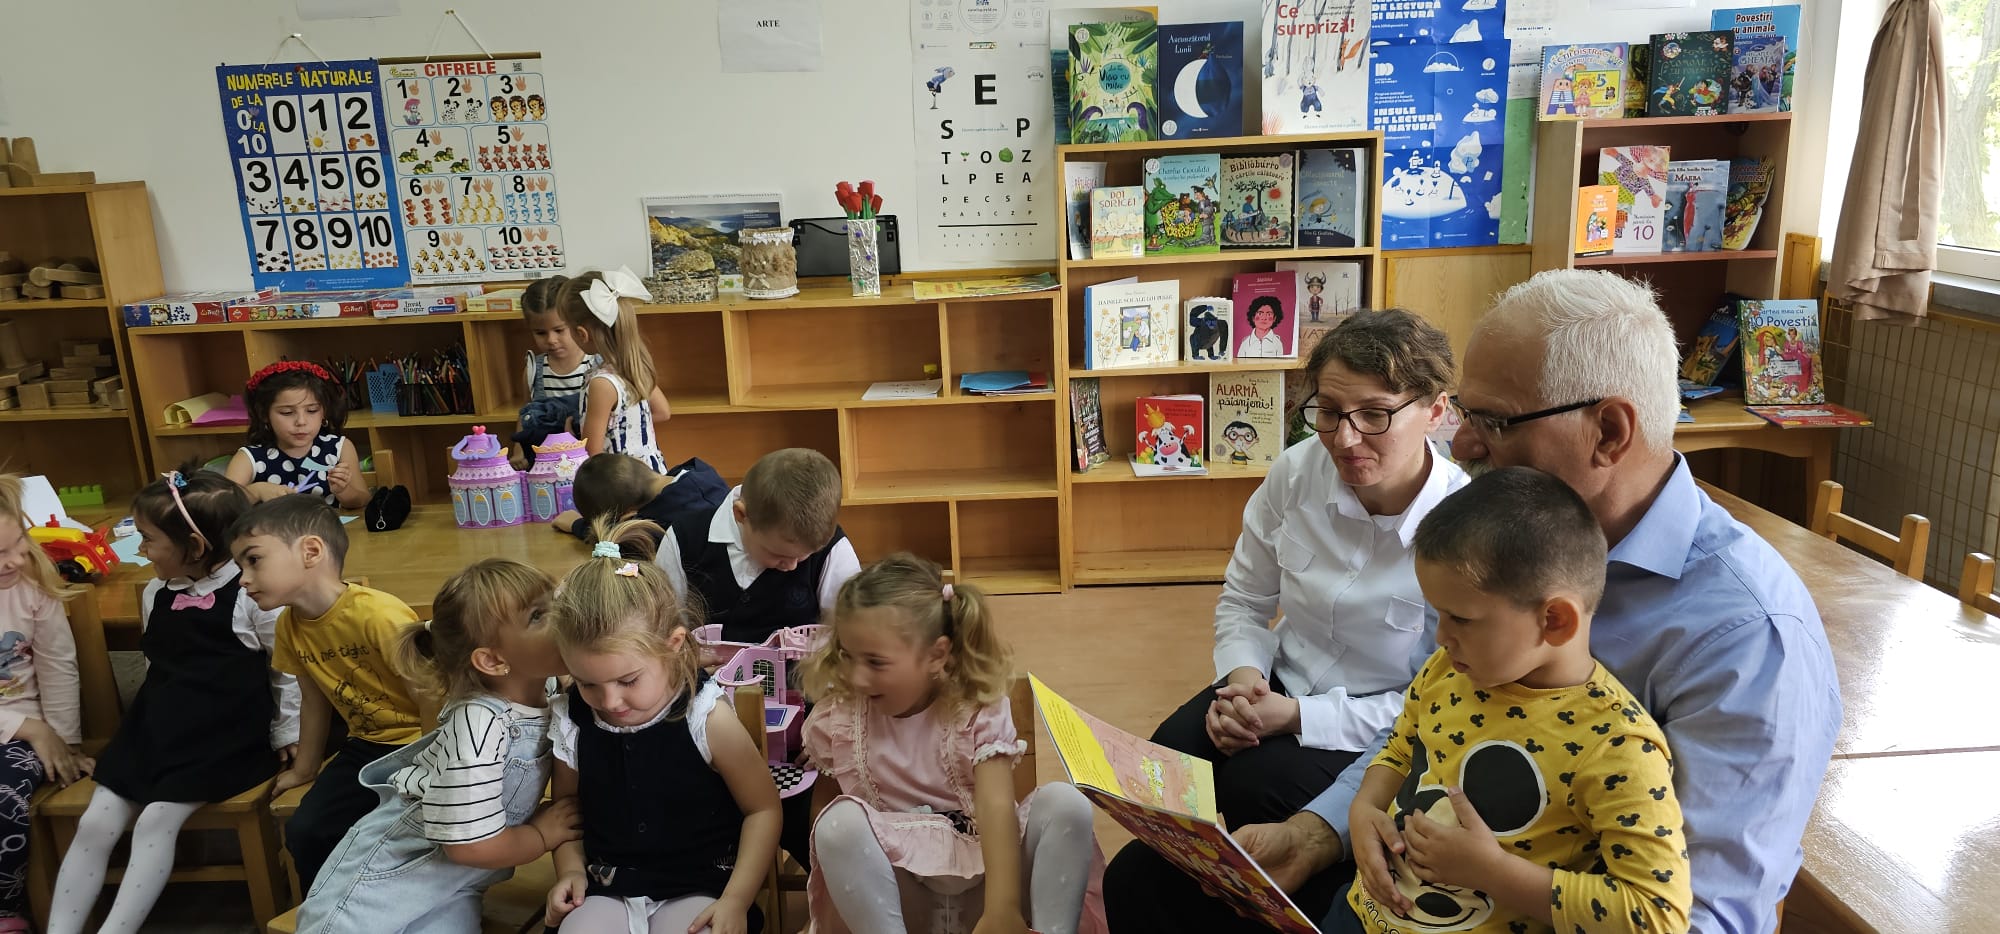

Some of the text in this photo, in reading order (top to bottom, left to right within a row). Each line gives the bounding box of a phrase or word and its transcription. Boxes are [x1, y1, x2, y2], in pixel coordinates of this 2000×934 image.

[1277, 5, 1299, 18] Ce
[1735, 12, 1773, 24] Povestiri
[756, 19, 781, 28] ARTE
[1276, 18, 1355, 39] surpriză!
[1742, 23, 1776, 34] animale
[1175, 45, 1192, 54] Lunii
[424, 61, 497, 77] CIFRELE
[227, 71, 293, 91] NUMERELE
[300, 69, 373, 87] NATURALE
[397, 79, 408, 99] 1
[447, 77, 461, 97] 2
[500, 75, 513, 94] 3
[974, 74, 997, 105] E
[232, 93, 263, 109] DE LA
[237, 109, 251, 131] 0
[272, 100, 297, 133] 0
[308, 99, 327, 131] 1
[345, 97, 370, 130] 2
[1374, 107, 1416, 116] INSULE
[1374, 116, 1389, 124] DE
[253, 121, 266, 134] LA
[497, 126, 510, 144] 5
[941, 118, 1030, 140] S P
[238, 134, 267, 155] 10
[416, 129, 430, 148] 4
[941, 150, 1031, 164] T O Z
[247, 161, 271, 192] 3
[283, 159, 309, 191] 4
[320, 158, 344, 190] 5
[355, 156, 380, 188] 6
[942, 172, 1031, 184] L P E A
[409, 178, 423, 197] 6
[460, 176, 473, 196] 7
[513, 175, 525, 194] 8
[1110, 191, 1125, 199] DOI
[256, 220, 279, 251] 7
[293, 218, 318, 250] 8
[327, 217, 353, 249] 9
[359, 215, 392, 248] 10
[427, 230, 440, 248] 9
[499, 227, 522, 245] 10
[1633, 225, 1654, 240] 10
[1216, 383, 1258, 398] ALARMĂ
[339, 643, 369, 658] tight
